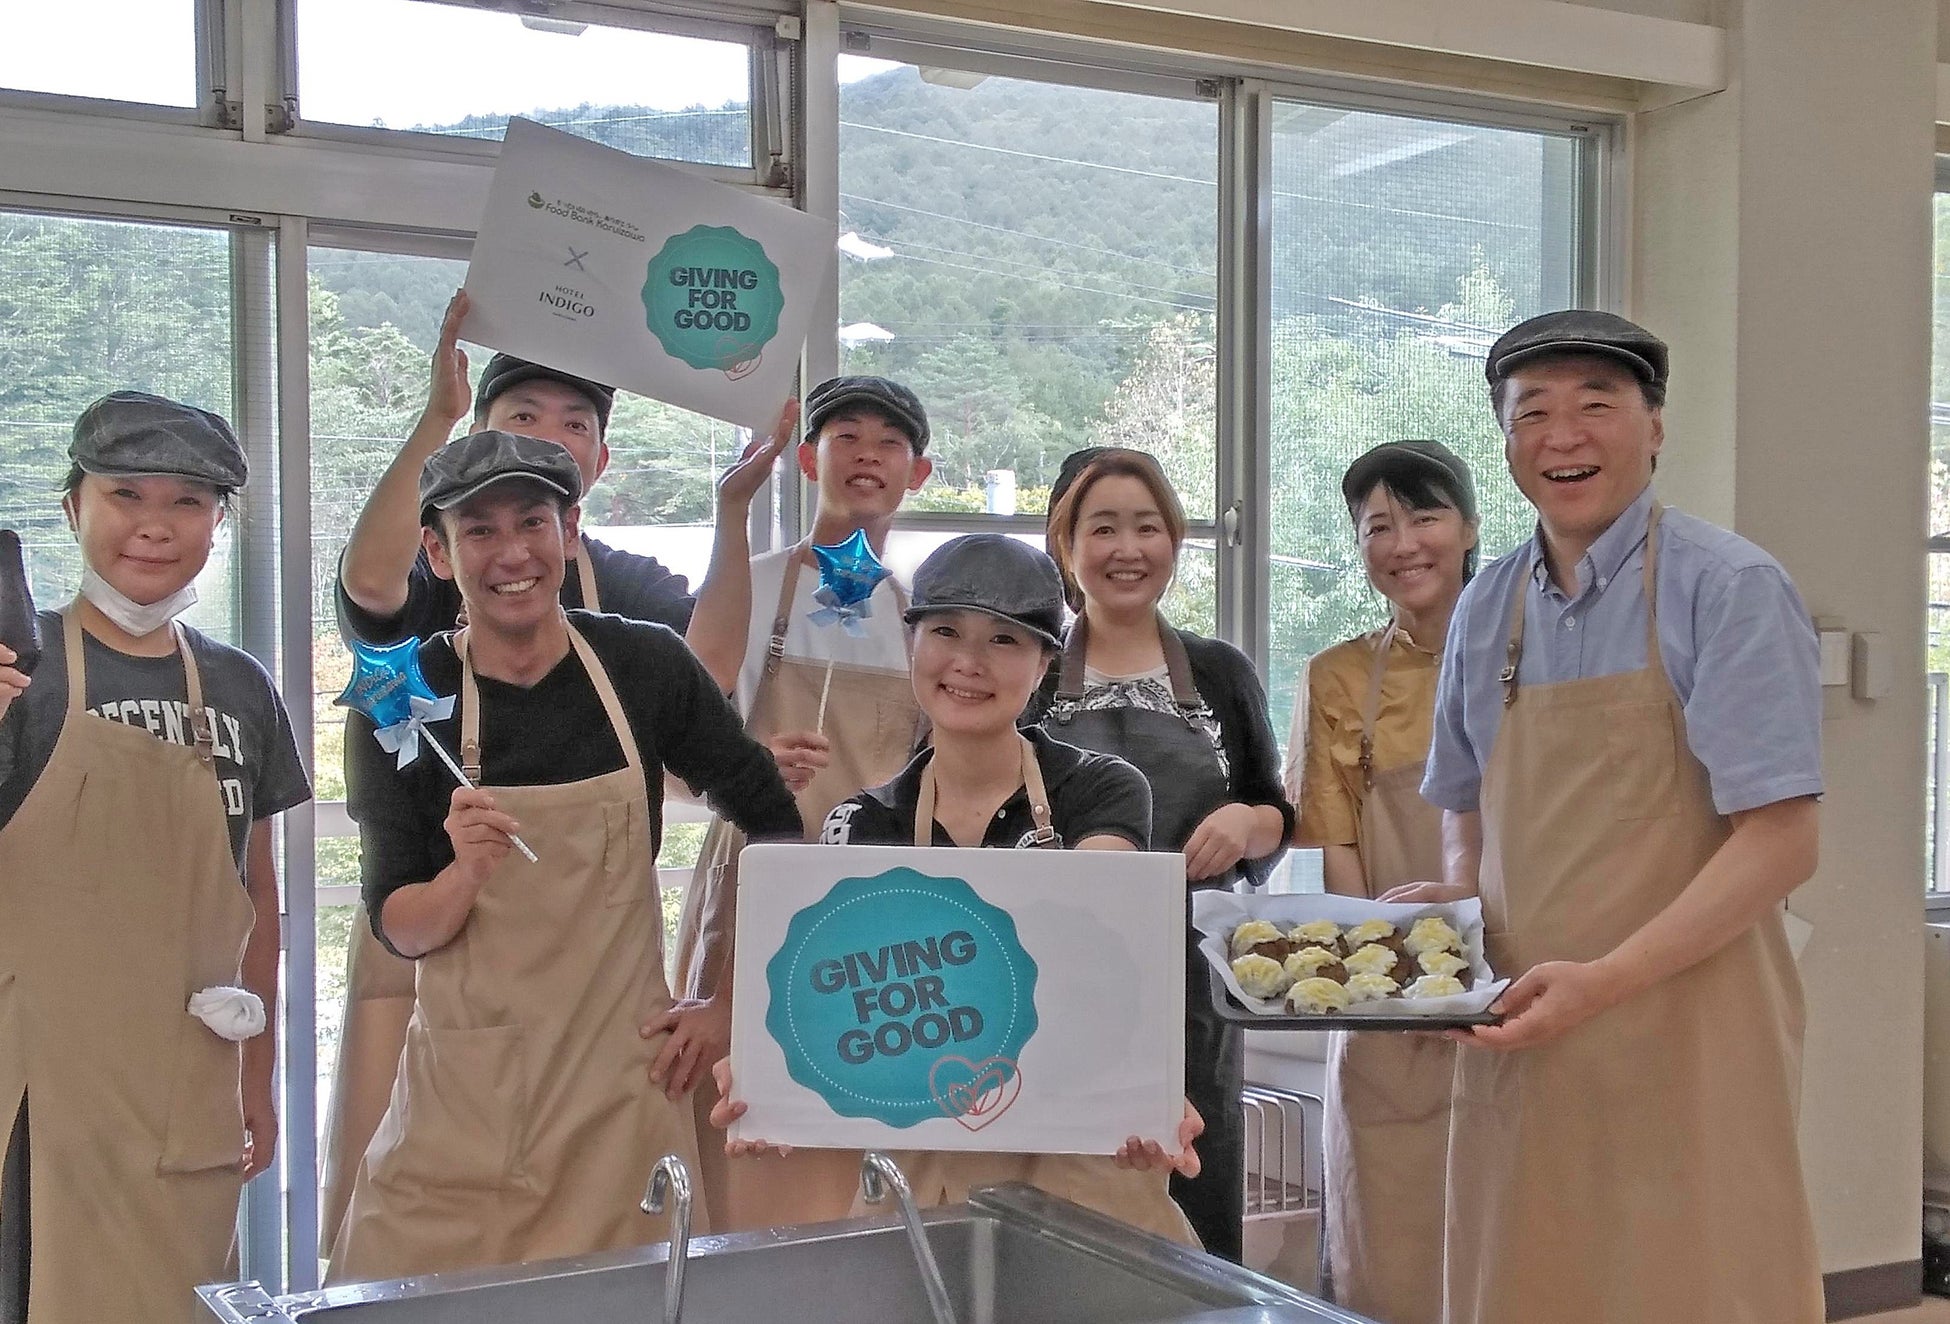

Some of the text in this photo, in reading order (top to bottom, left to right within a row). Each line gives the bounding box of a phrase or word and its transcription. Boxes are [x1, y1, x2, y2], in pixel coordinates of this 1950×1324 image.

[545, 202, 569, 218] Food
[571, 211, 594, 226] Bank
[669, 266, 758, 290] GIVING
[539, 291, 595, 318] INDIGO
[555, 285, 584, 299] HOTEL
[688, 288, 737, 310] FOR
[673, 309, 752, 332] GOOD
[84, 699, 244, 766] CENLY
[809, 930, 978, 995] GIVING
[852, 975, 951, 1025] FOR
[836, 1005, 984, 1065] GOOD
